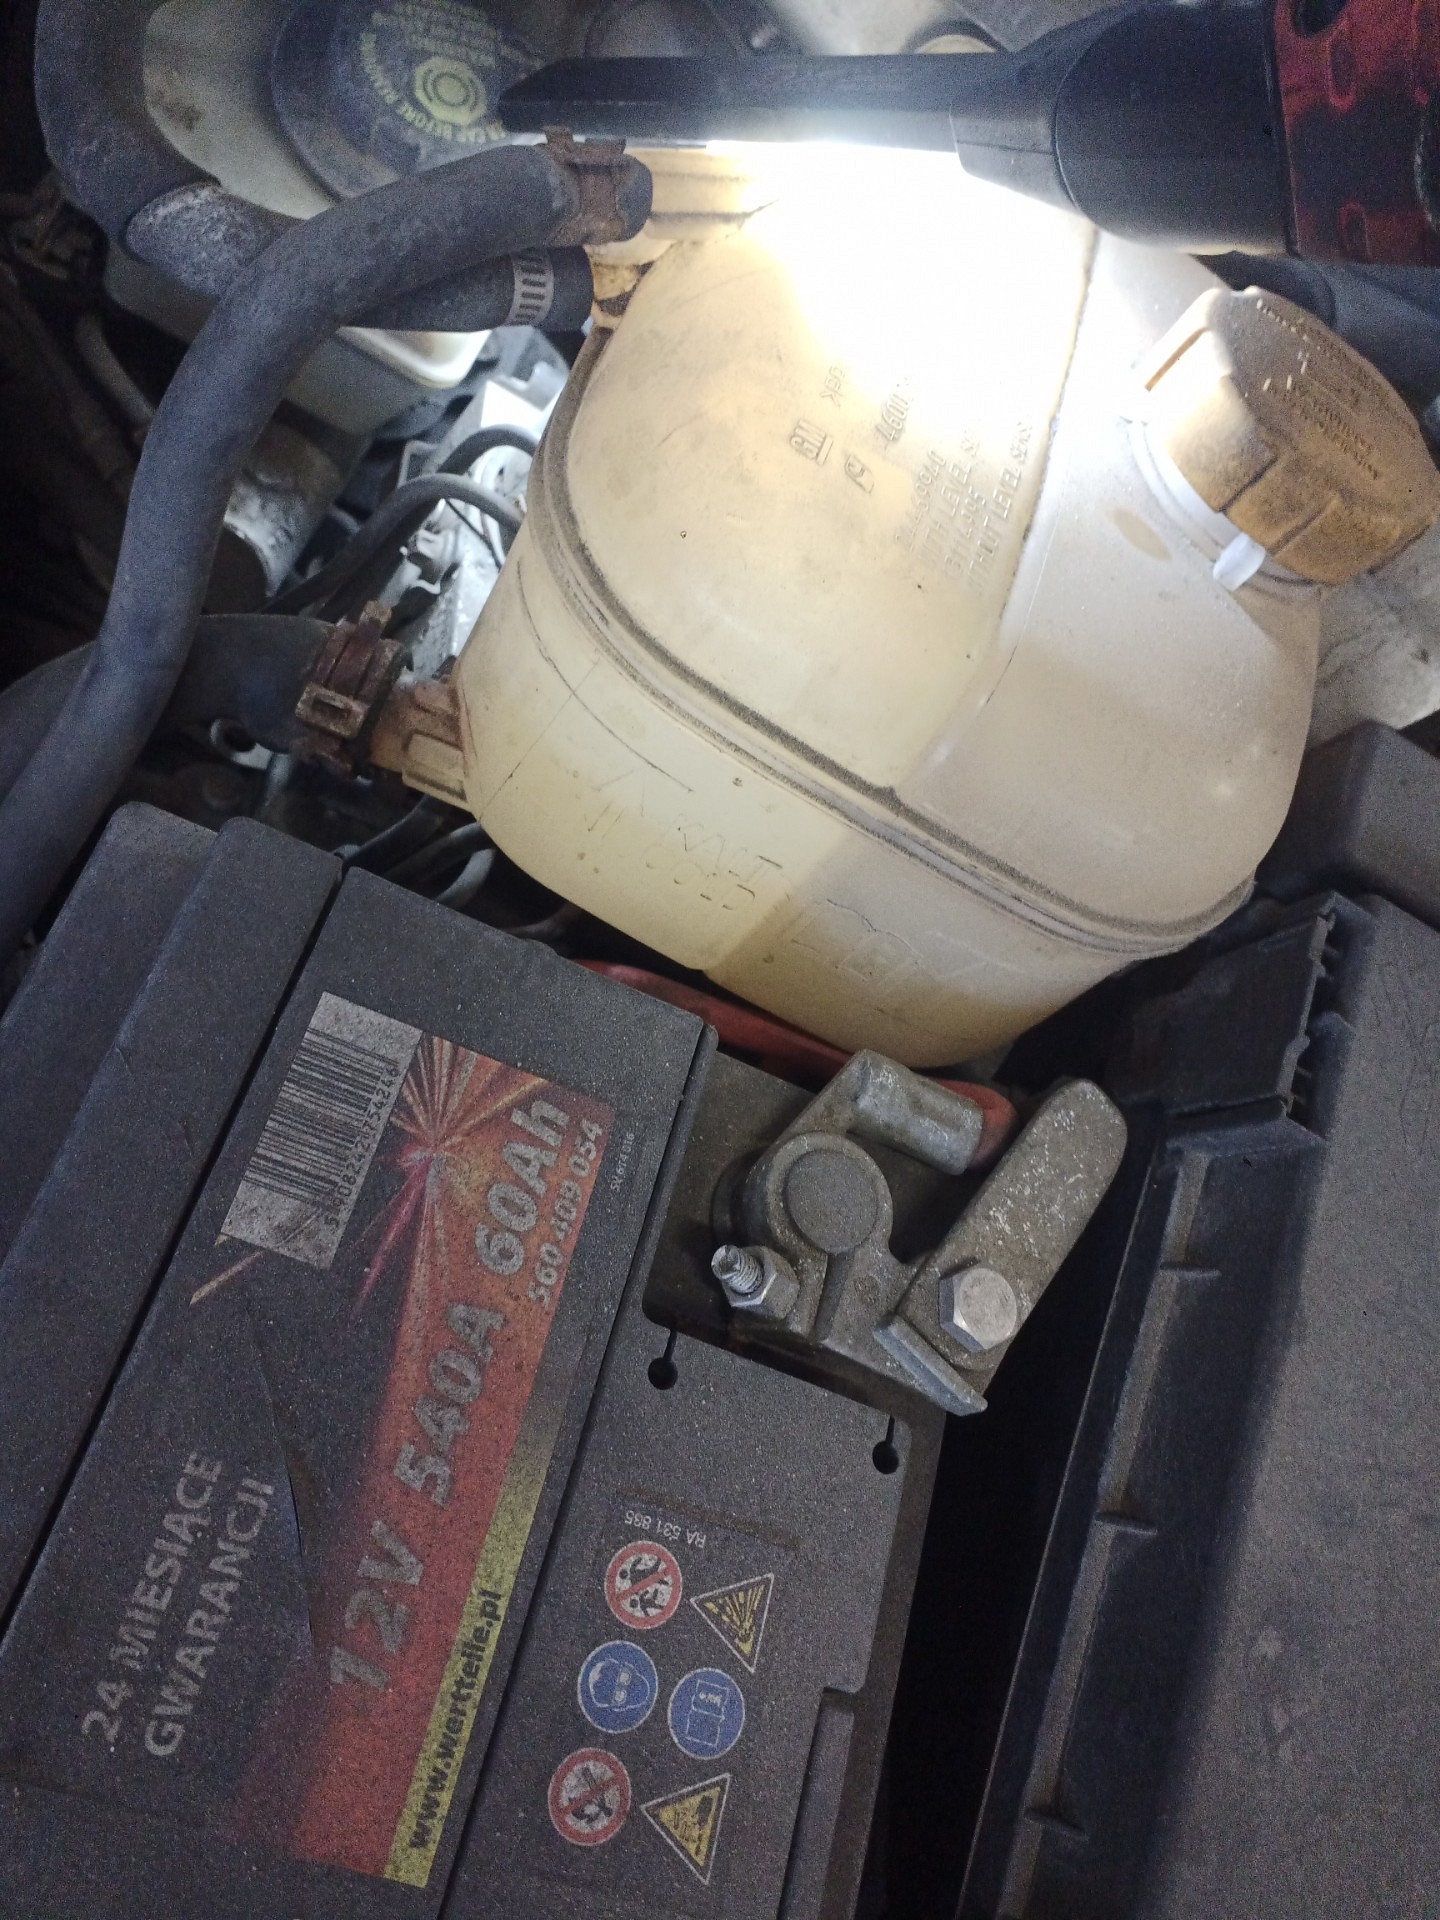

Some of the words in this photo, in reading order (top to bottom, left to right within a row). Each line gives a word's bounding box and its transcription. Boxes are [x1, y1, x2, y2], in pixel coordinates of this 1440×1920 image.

[934, 463, 971, 519] LEVEL
[987, 467, 1021, 520] LEVEL
[525, 1241, 566, 1308] 560
[565, 1117, 605, 1178] 054
[327, 1520, 431, 1692] 12V
[393, 1300, 504, 1505] 540A
[474, 1093, 572, 1276] 60Ah
[686, 1528, 706, 1548] RA
[144, 1478, 273, 1757] GWARANCJI
[83, 1672, 136, 1744] 24
[406, 1587, 506, 1850] www.wertteile.pl
